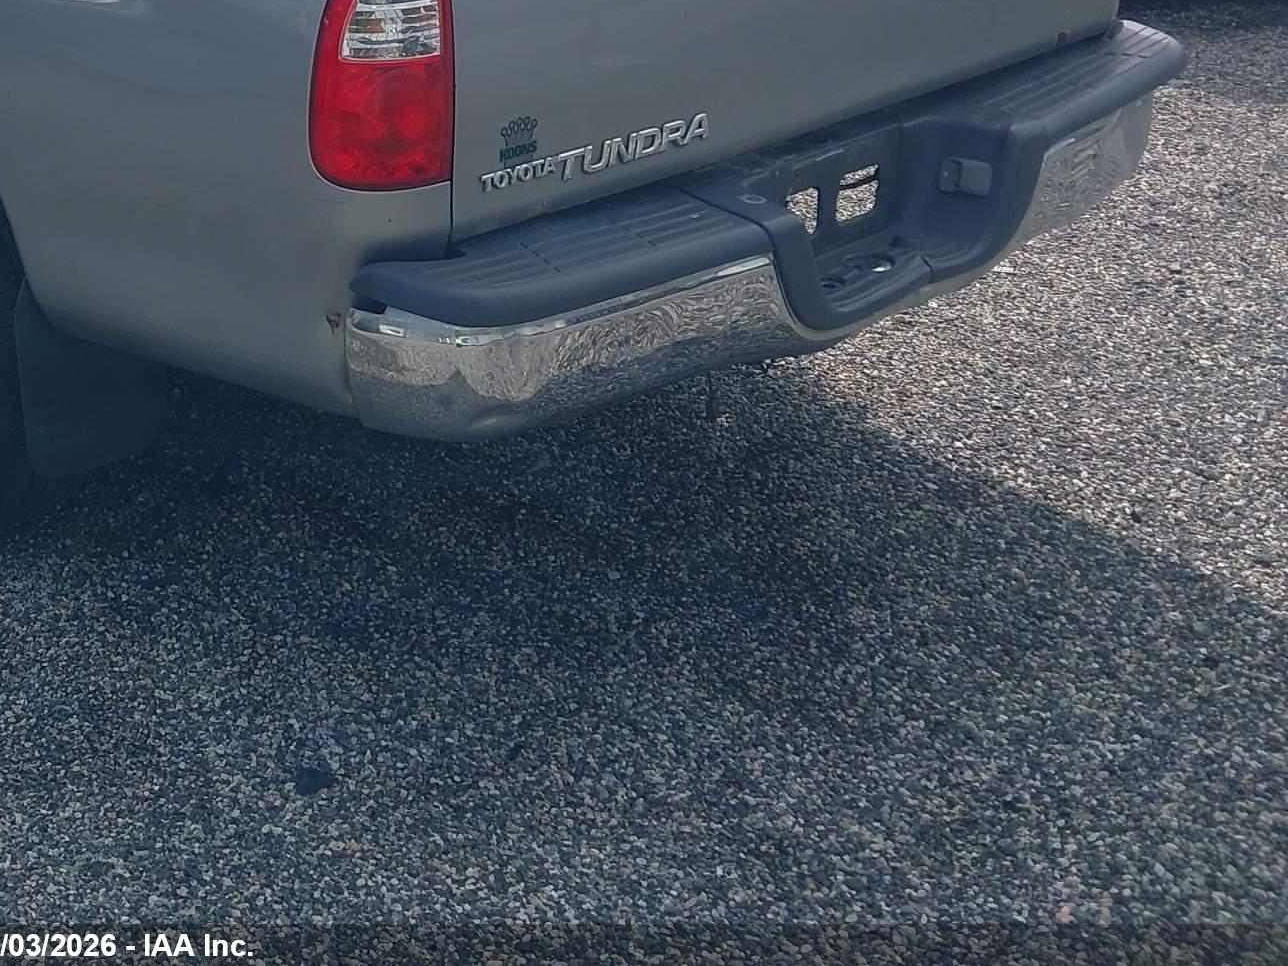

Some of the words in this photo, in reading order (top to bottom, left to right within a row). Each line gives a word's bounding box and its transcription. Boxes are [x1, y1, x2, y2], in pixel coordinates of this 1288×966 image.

[480, 156, 557, 193] TOYOTA
[556, 111, 710, 181] TUNDRA
[499, 140, 538, 162] KOONS
